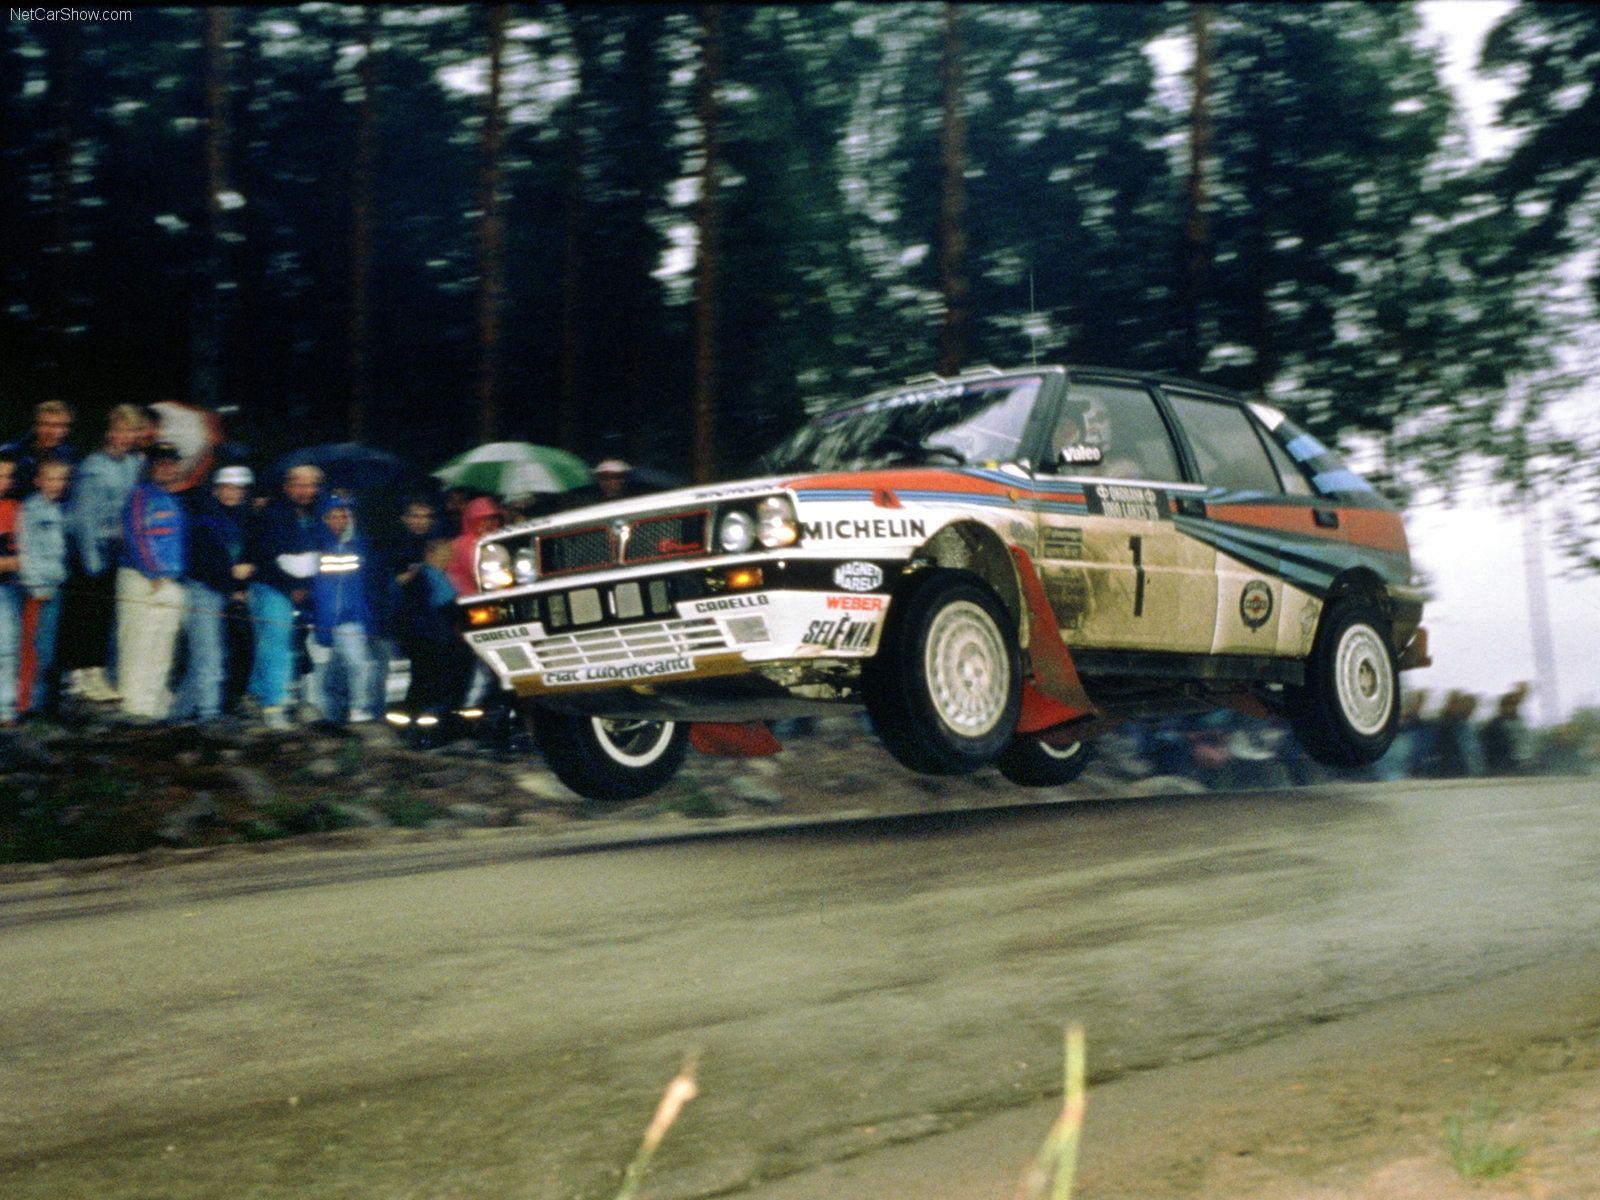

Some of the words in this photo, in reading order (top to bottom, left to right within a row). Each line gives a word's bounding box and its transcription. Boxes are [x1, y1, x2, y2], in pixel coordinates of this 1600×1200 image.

[799, 519, 926, 540] MICHELIN
[1129, 534, 1145, 617] 1
[695, 594, 769, 613] CARELLO
[826, 596, 882, 611] WEBER
